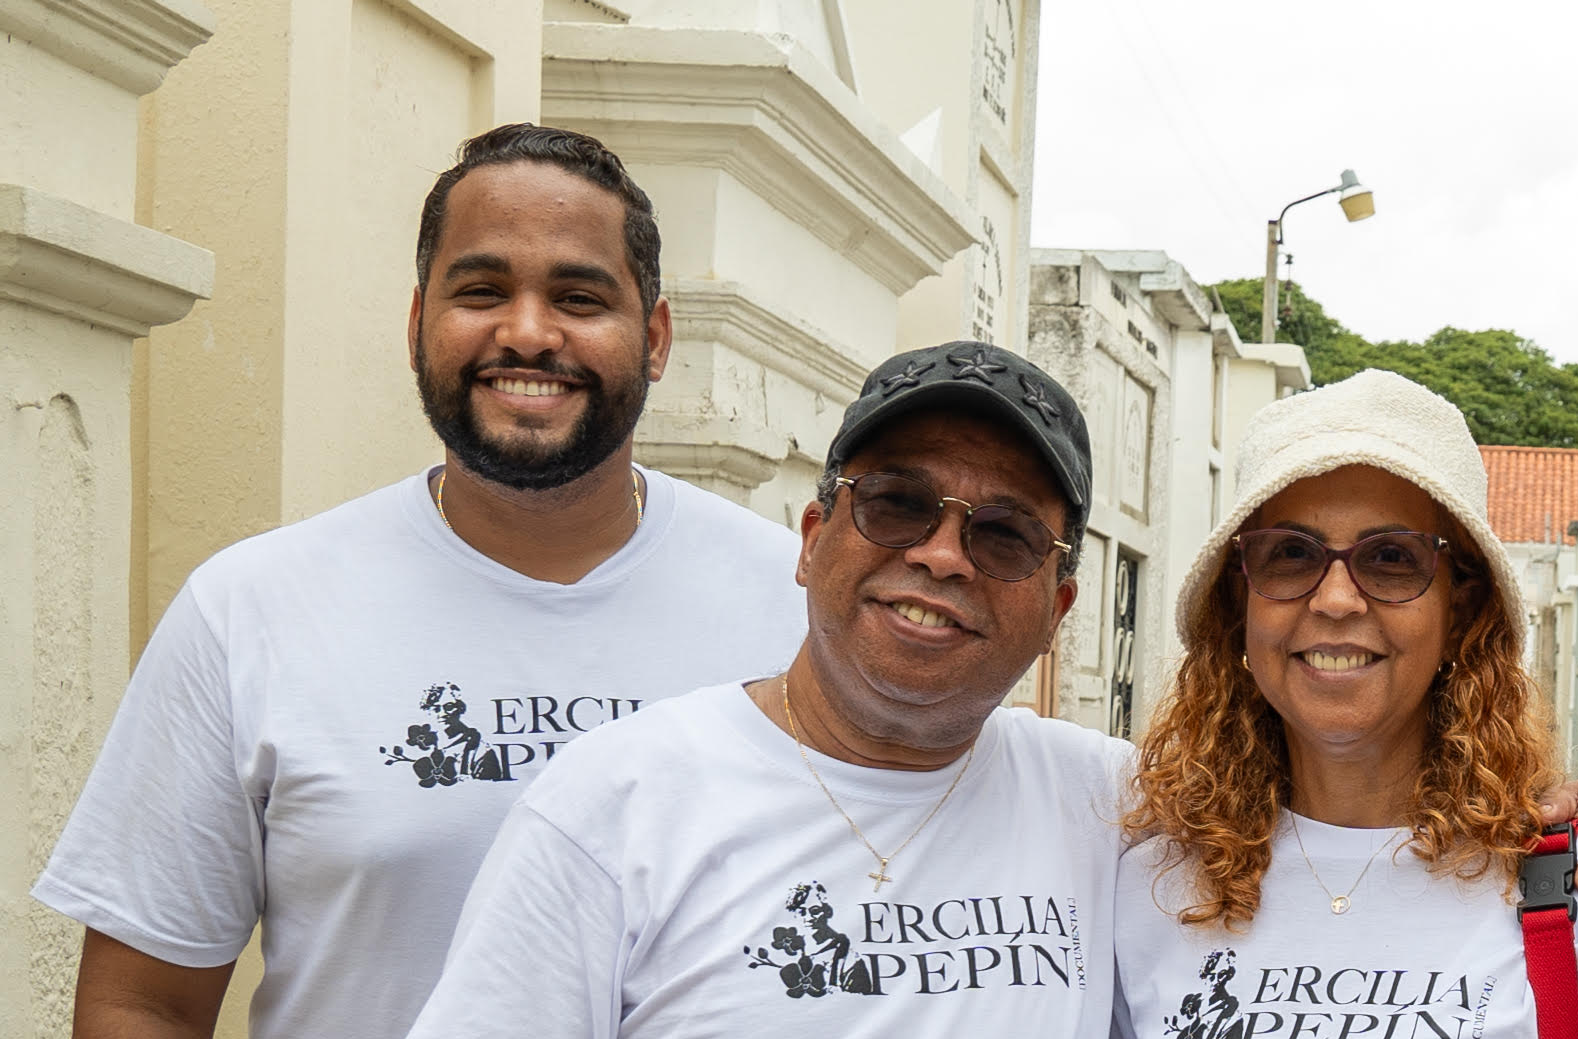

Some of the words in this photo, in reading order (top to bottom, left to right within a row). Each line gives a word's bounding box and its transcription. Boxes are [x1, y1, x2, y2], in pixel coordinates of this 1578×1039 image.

[857, 896, 1070, 944] ERCILIA
[860, 933, 1072, 996] PEPÍN
[1250, 965, 1472, 1011] ERCILIA
